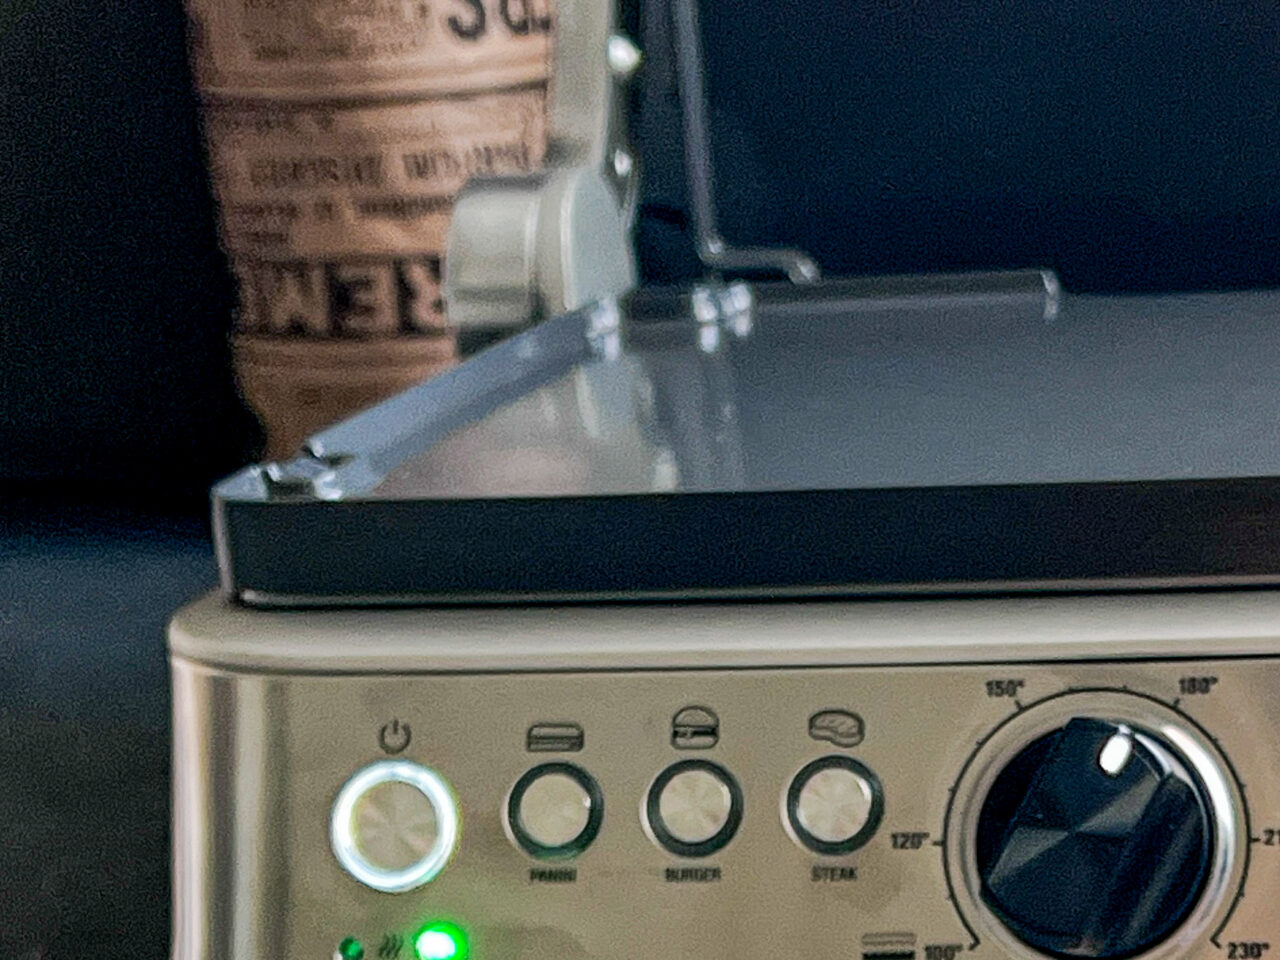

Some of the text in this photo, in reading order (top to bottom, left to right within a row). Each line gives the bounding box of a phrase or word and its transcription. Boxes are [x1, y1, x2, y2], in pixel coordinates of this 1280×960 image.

[890, 830, 930, 850] 120°
[665, 867, 722, 883] BURGER
[811, 866, 858, 882] STEAK
